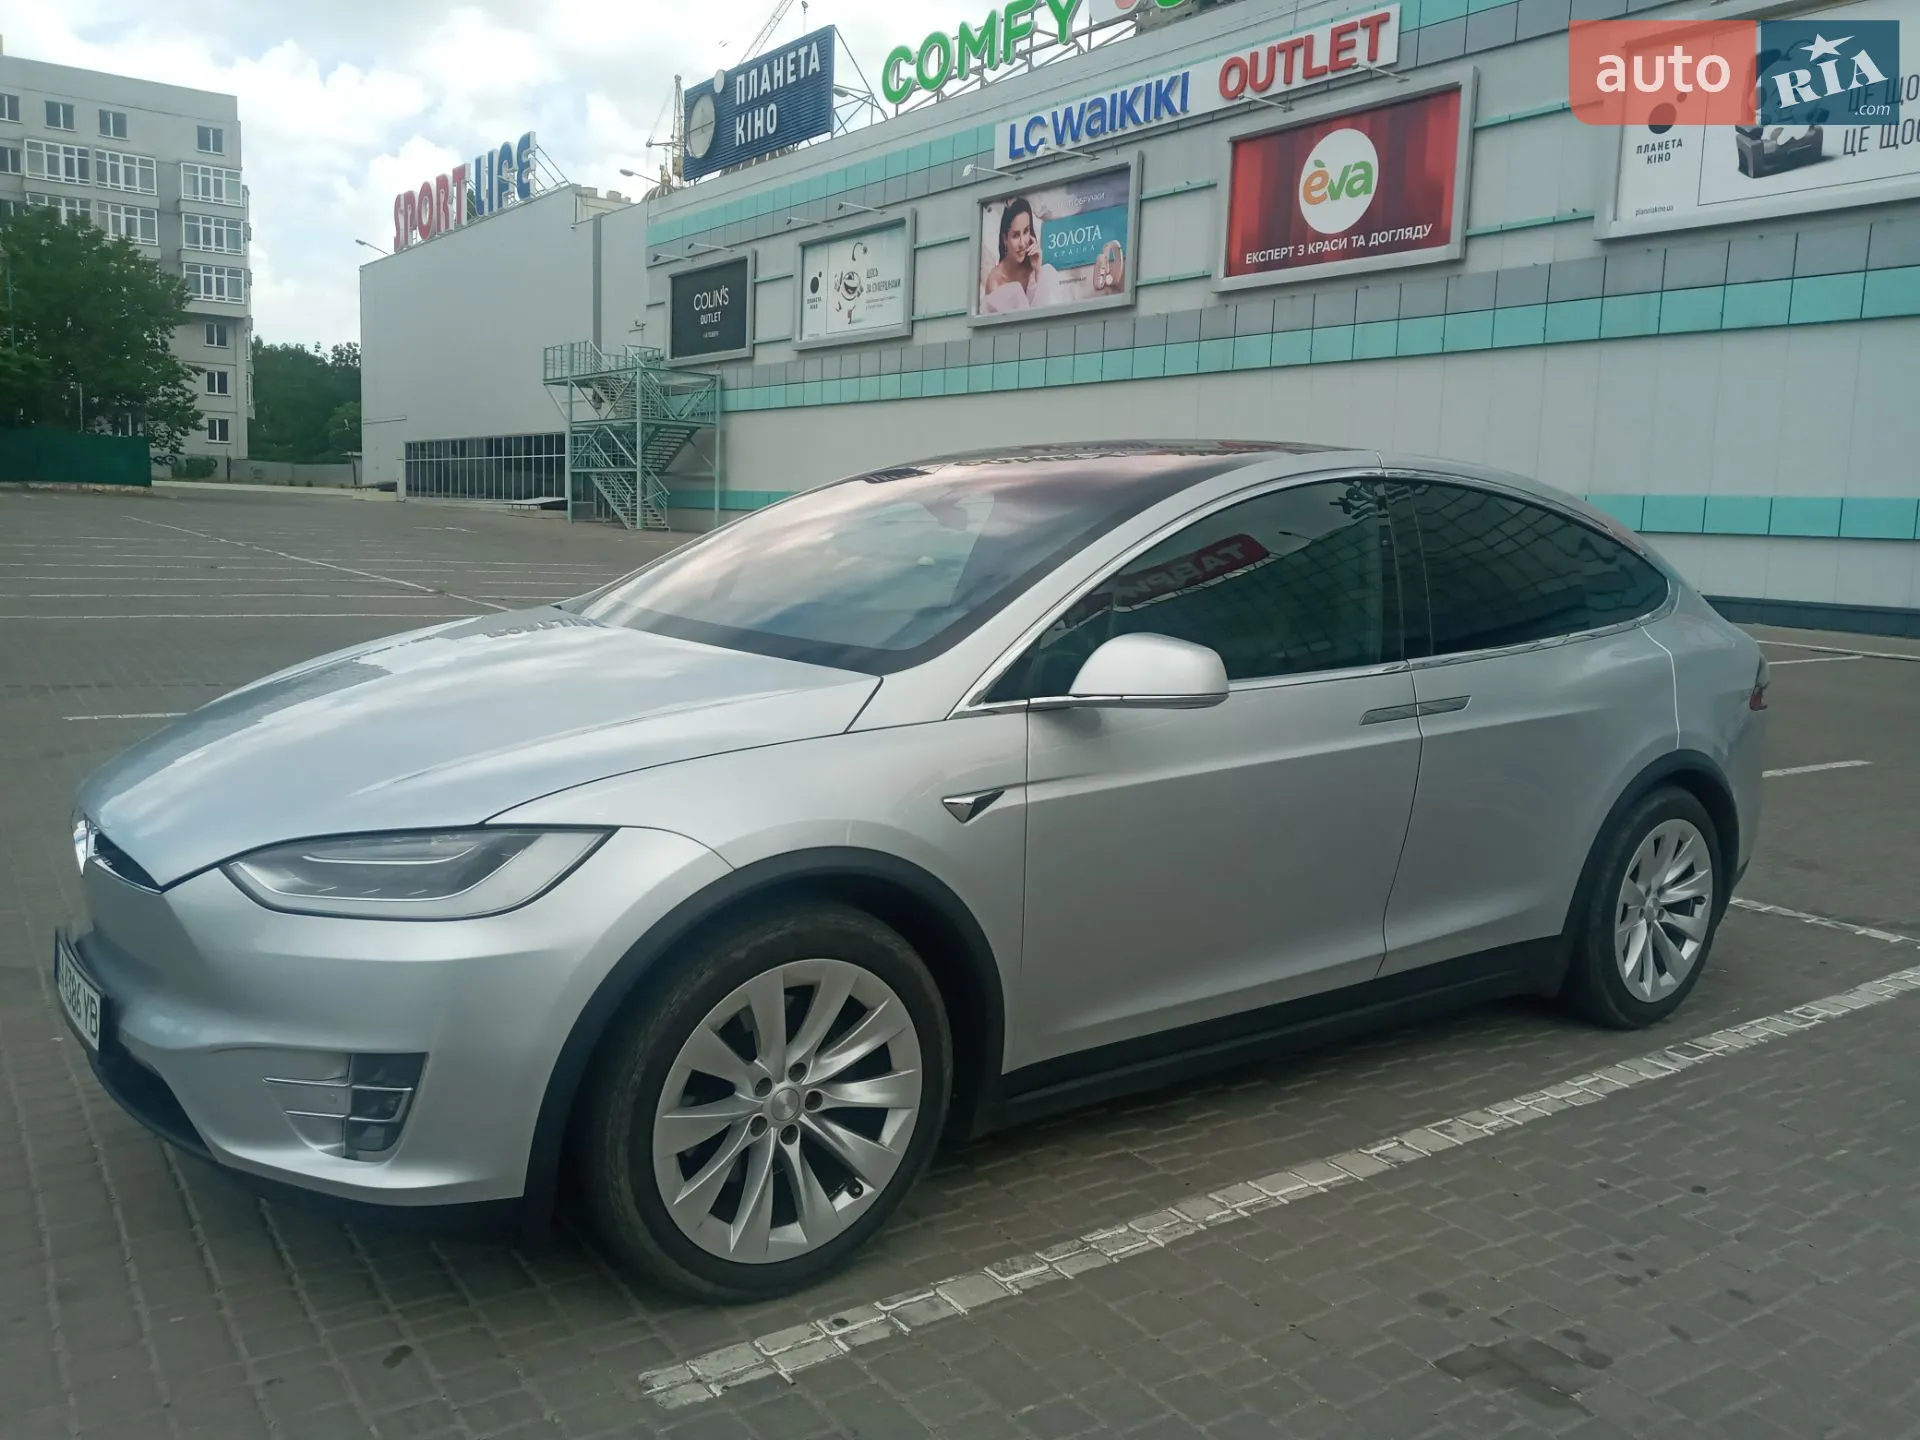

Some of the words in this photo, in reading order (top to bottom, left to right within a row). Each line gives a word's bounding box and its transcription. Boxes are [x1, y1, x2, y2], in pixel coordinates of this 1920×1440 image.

[882, 0, 1079, 104] COMFY
[1219, 12, 1391, 100] OUTLET
[736, 41, 821, 106] ПЛАНЕТА
[735, 103, 777, 147] КІНО
[1843, 126, 1870, 157] ЦЕ
[1636, 137, 1683, 154] ПЛАНЕТА
[1646, 151, 1671, 165] КІНО
[394, 163, 469, 253] SPORT
[475, 131, 536, 217] LIFE
[1048, 224, 1102, 250] ЗОЛОТА
[1245, 245, 1294, 265] ЕКСПЕРТ
[1308, 238, 1347, 255] КРАСИ
[1351, 236, 1366, 248] ТА
[1369, 223, 1433, 247] ДОГЛЯДУ
[693, 285, 729, 311] COLIN'S
[700, 311, 721, 325] OUTLET
